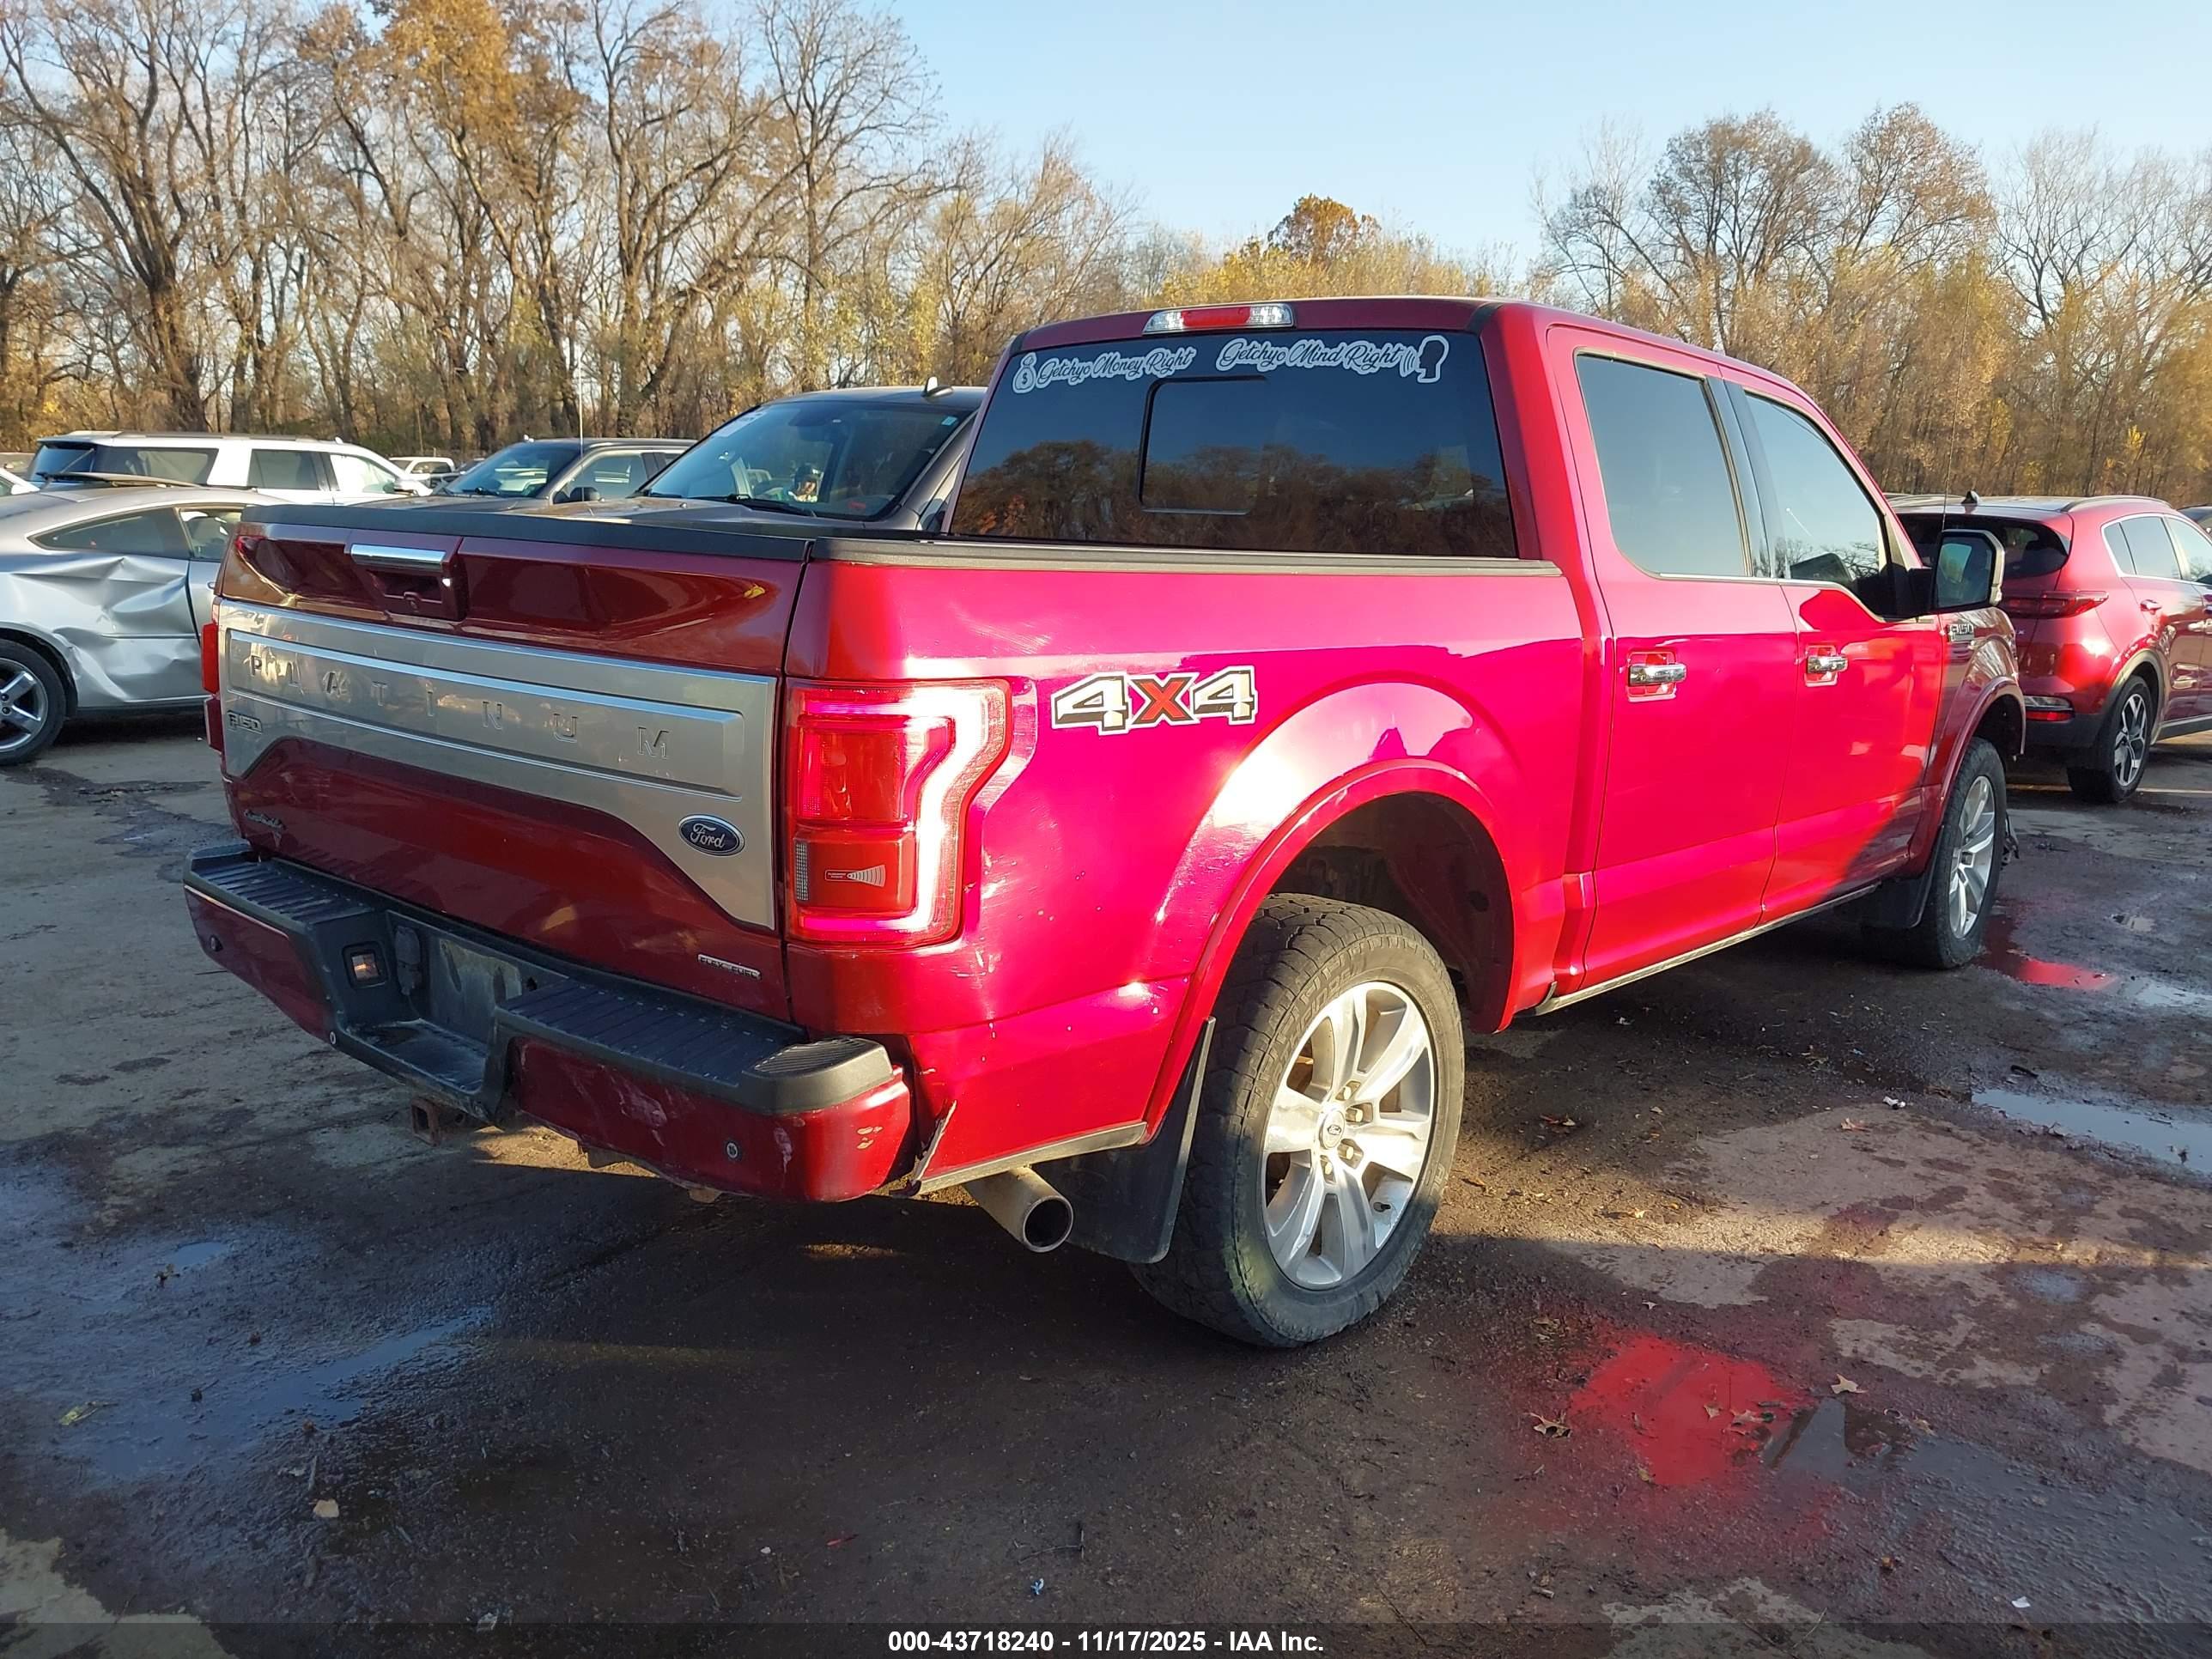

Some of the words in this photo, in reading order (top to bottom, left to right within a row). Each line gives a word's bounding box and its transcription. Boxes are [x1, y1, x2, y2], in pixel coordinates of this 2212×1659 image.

[1037, 359, 1092, 386] Getchyo
[1093, 354, 1145, 379] Money
[1146, 349, 1196, 375] Right
[1218, 340, 1287, 369] Getchyo
[1289, 340, 1342, 366] Mind
[1345, 341, 1401, 371] Right
[248, 653, 670, 760] PLATINUM
[690, 823, 726, 849] Ford
